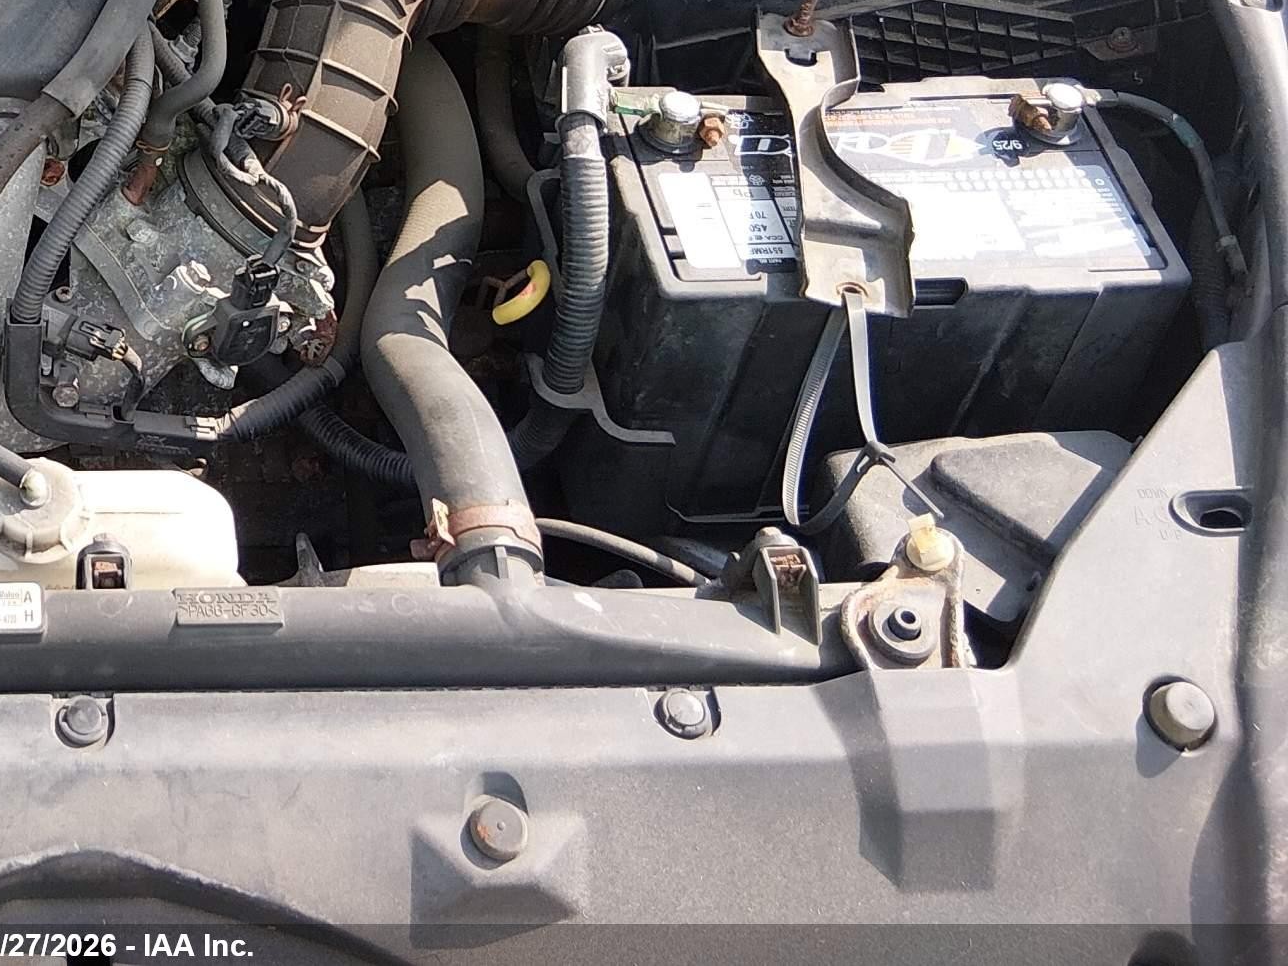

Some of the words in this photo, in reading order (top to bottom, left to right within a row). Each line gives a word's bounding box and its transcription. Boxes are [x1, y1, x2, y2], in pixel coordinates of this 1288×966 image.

[992, 139, 1023, 151] 9/25
[23, 591, 33, 603] A
[24, 610, 34, 622] H
